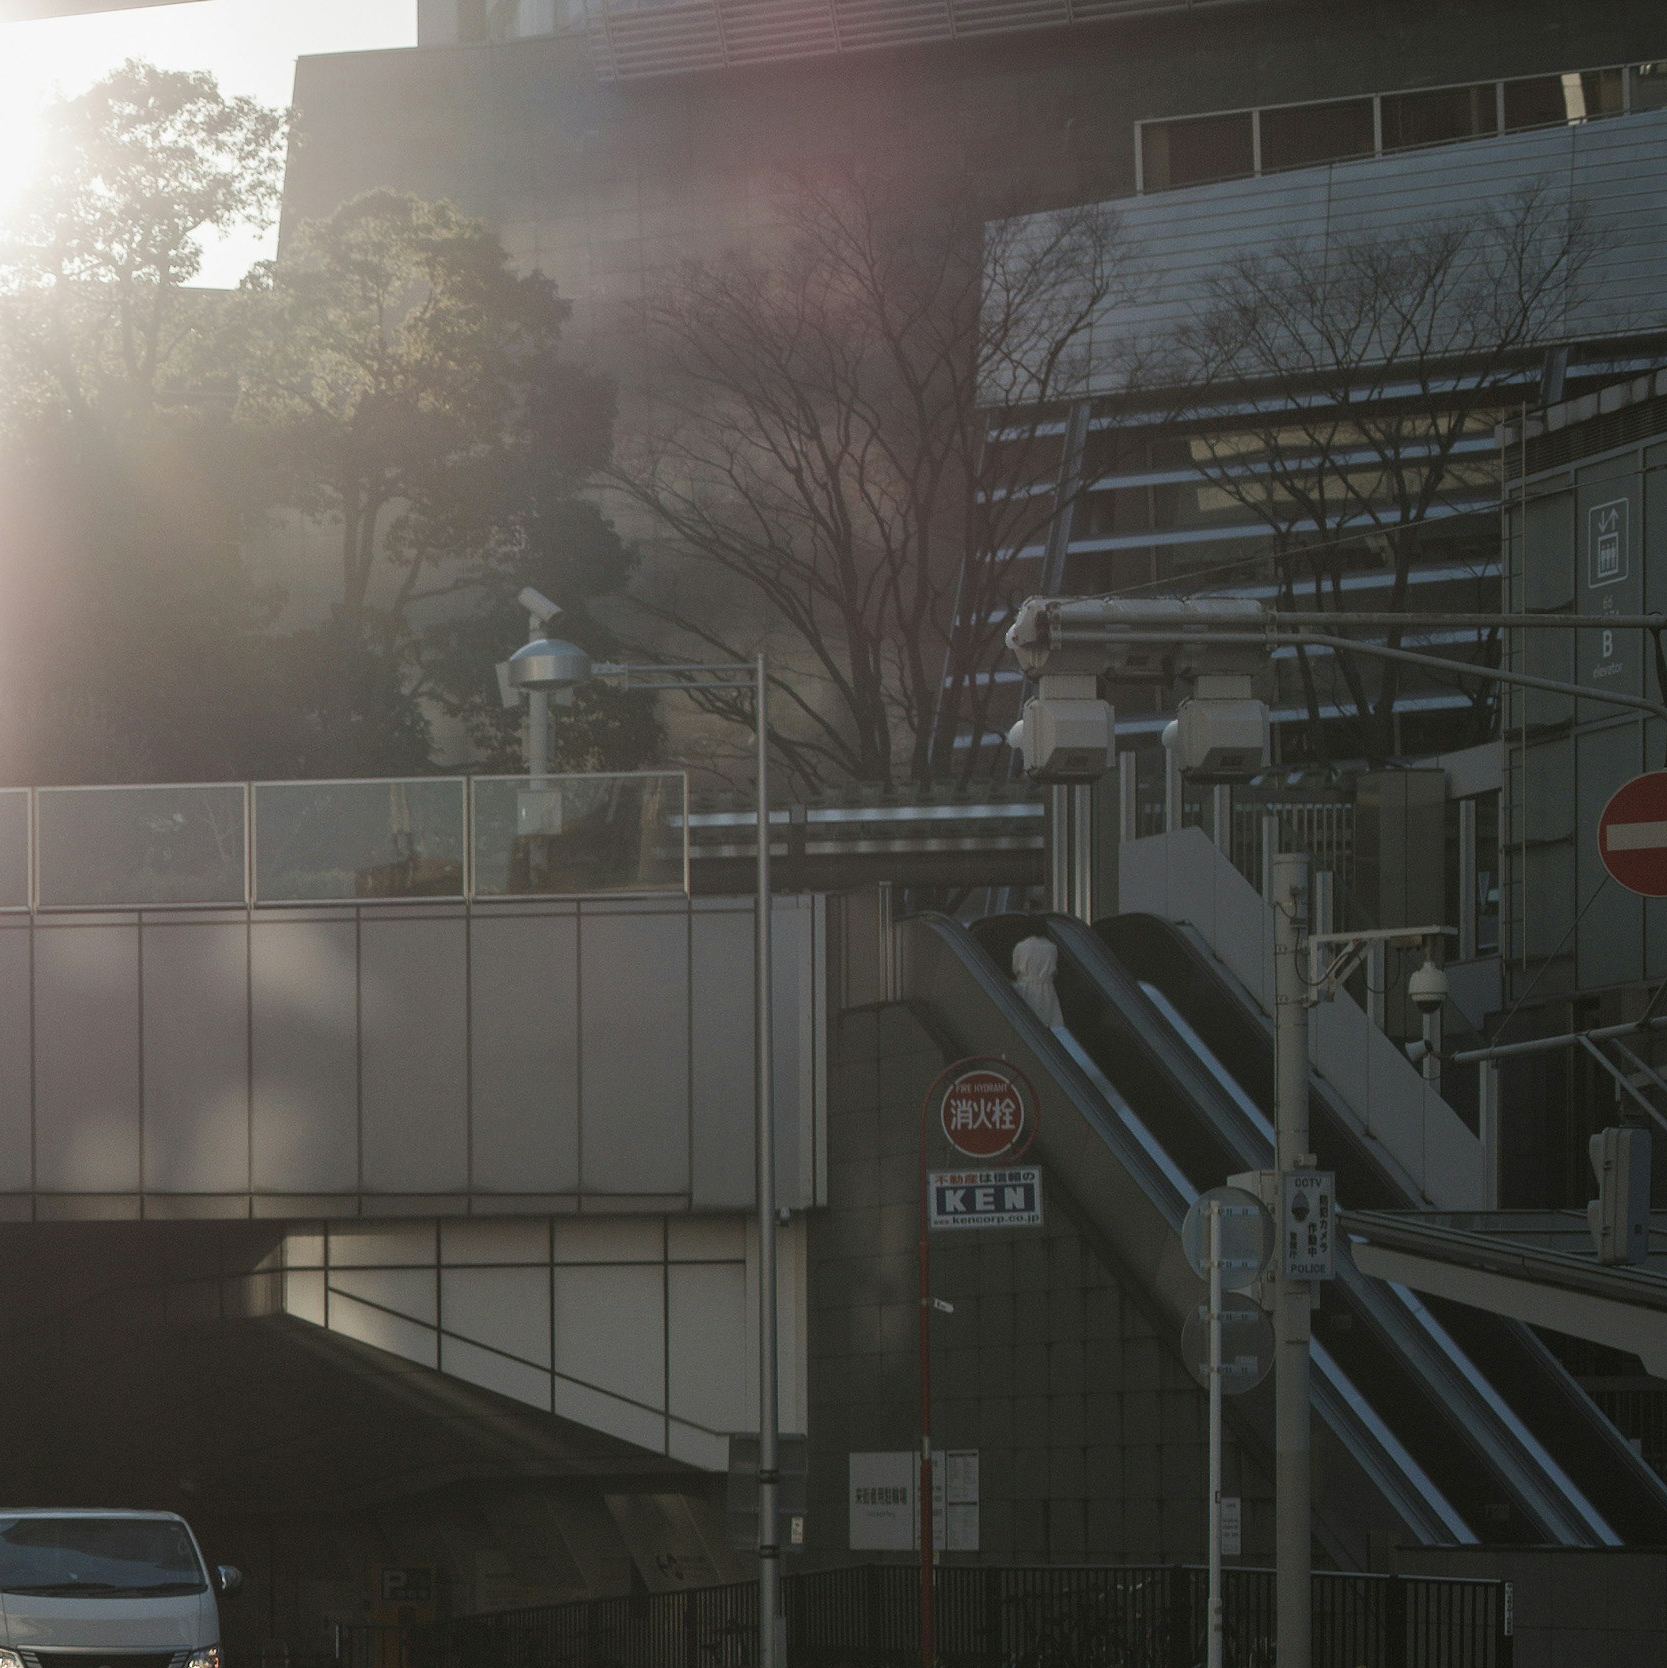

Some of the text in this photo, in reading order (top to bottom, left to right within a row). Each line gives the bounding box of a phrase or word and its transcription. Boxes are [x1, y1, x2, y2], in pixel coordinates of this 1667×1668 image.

[1603, 629, 1613, 658] B
[955, 1082, 1009, 1094] FIRE HYDRANT
[950, 1097, 1016, 1131] 消火栓
[1294, 1178, 1322, 1188] CCTV
[944, 1186, 1025, 1213] KEN
[1319, 1194, 1329, 1253] 防犯カメラ
[1290, 1264, 1327, 1274] POLICE
